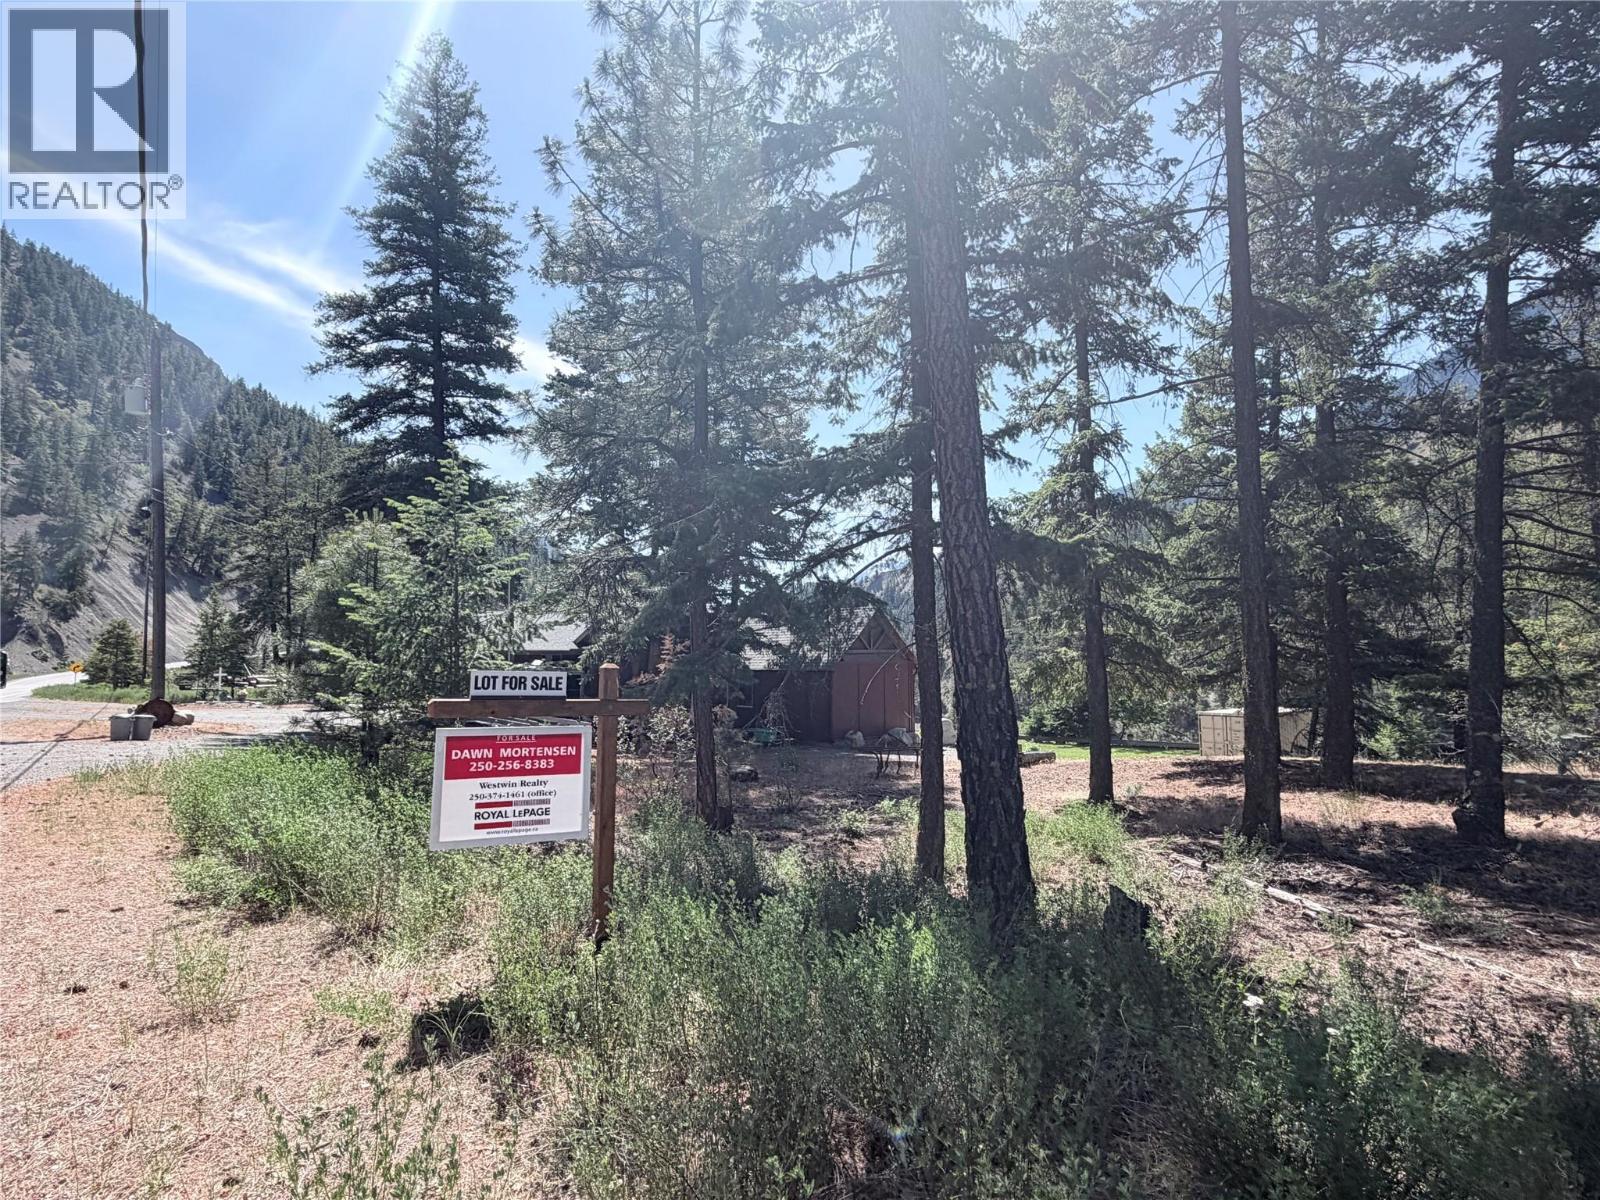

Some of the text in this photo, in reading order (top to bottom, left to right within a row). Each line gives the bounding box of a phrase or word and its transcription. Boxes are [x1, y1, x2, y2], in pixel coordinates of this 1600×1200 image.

[474, 675, 564, 691] LOT FOR SALE
[516, 734, 536, 742] SALE
[451, 745, 577, 760] DAWN MORTENSEN
[468, 758, 555, 772] 250-256-8383
[479, 779, 549, 790] Westwin Realty
[468, 789, 557, 801] 250-374-1461 (office)
[474, 810, 510, 821] ROYAL
